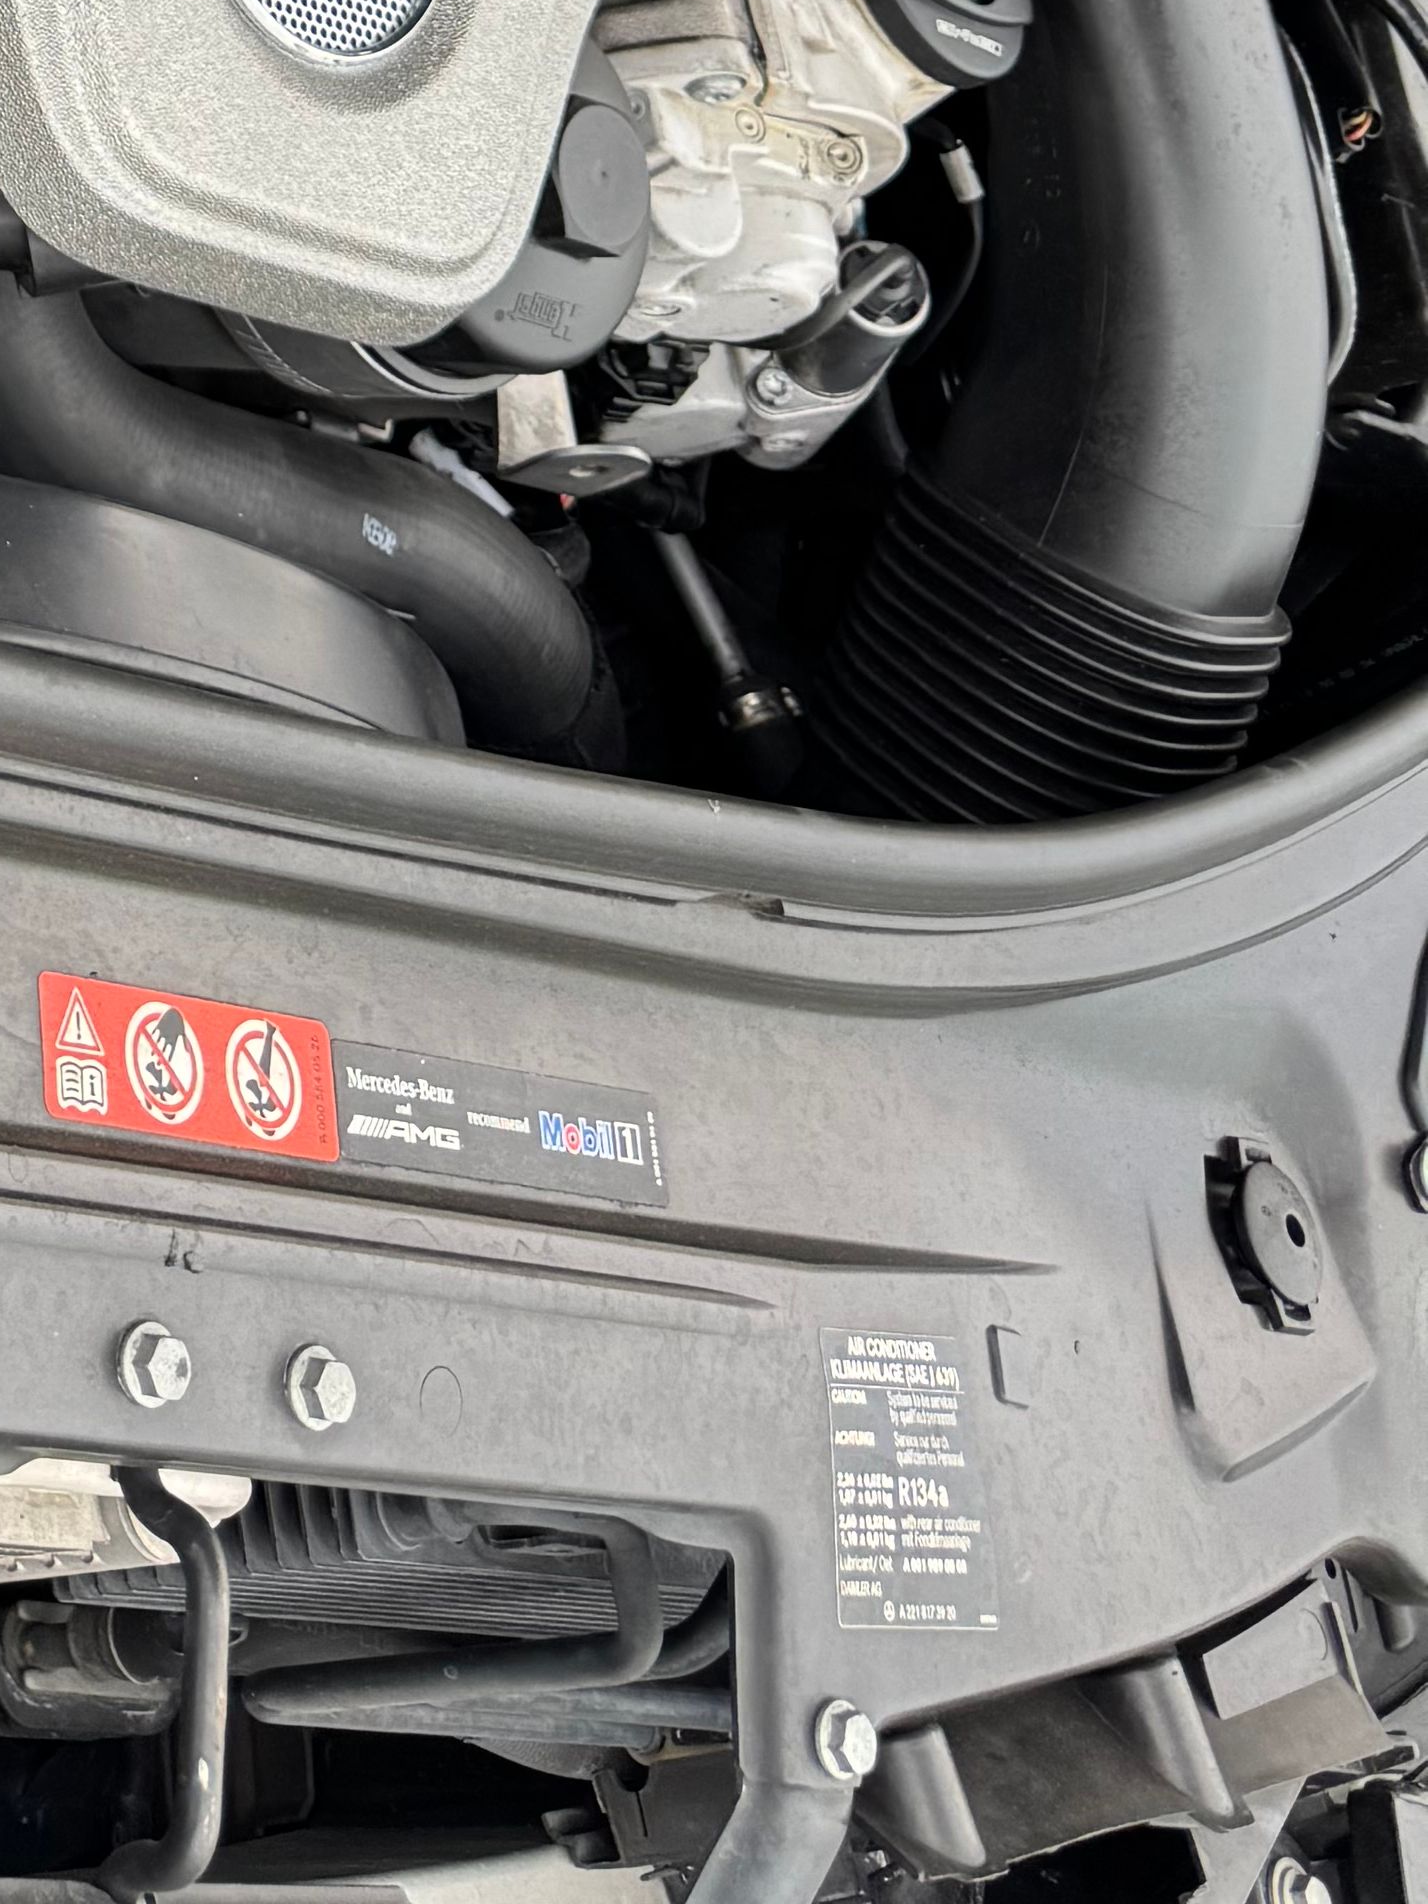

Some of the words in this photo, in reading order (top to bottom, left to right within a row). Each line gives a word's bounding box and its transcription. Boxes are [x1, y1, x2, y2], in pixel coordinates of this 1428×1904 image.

[346, 1066, 455, 1105] Mercedes-Benz
[467, 1111, 531, 1134] recommend
[538, 1110, 615, 1161] Mobil
[848, 1336, 866, 1358] AIR
[866, 1337, 936, 1362] CONDITIONER
[898, 1476, 949, 1508] R134a
